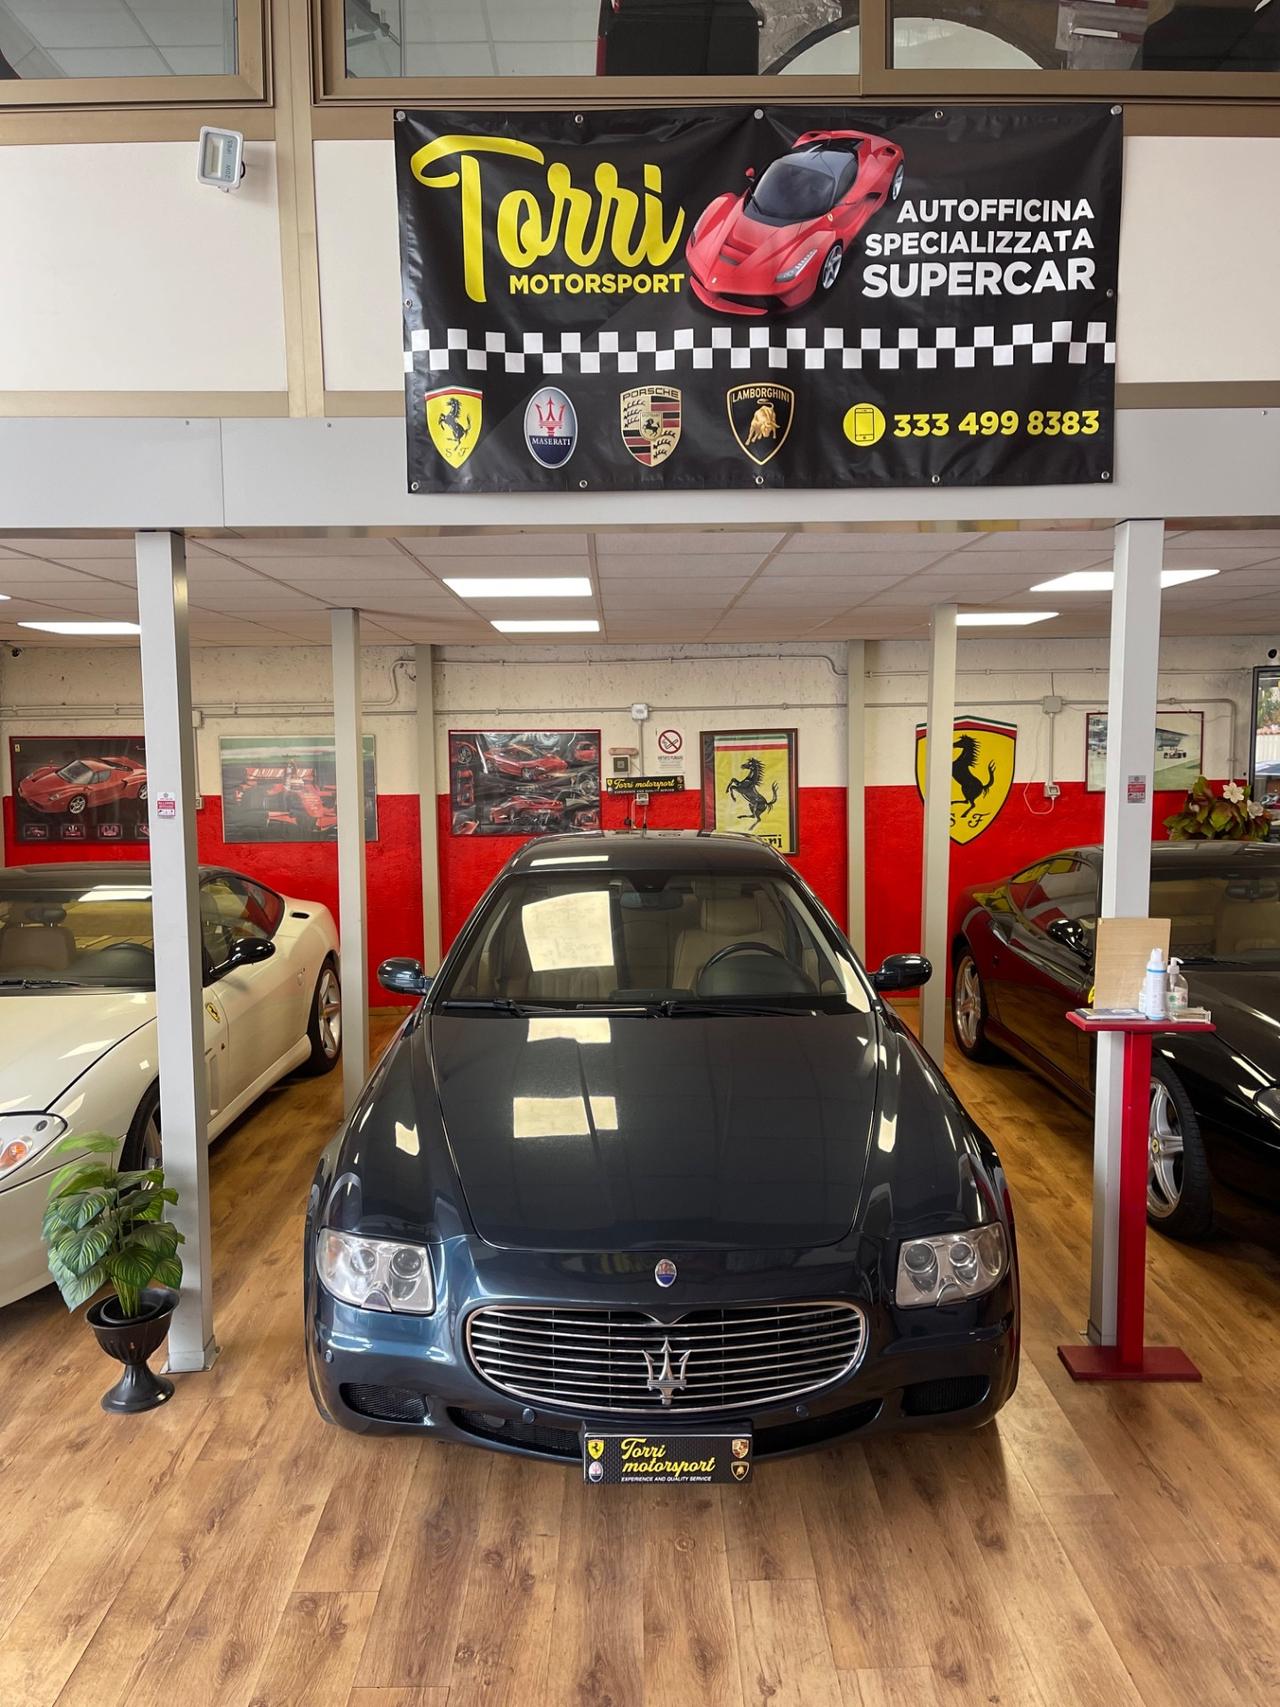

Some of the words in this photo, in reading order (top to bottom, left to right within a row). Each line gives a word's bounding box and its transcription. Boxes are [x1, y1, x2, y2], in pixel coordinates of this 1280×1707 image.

[410, 134, 686, 303] Torri
[896, 198, 1095, 223] AUTOFFICINA
[865, 227, 1095, 257] SPECIALIZZATA
[509, 273, 685, 295] MOTORSPORT
[861, 257, 1096, 298] SUPERCAR
[622, 387, 679, 401] PORSCHE
[732, 387, 790, 403] LAMBORGHINI
[893, 413, 950, 437] 333
[958, 410, 1019, 436] 499
[1026, 410, 1100, 436] 8383
[531, 437, 571, 446] MASERATI
[613, 778, 634, 790] Torri
[634, 778, 675, 790] motorsport
[621, 1438, 666, 1460] Torri
[622, 1457, 716, 1477] motorsport
